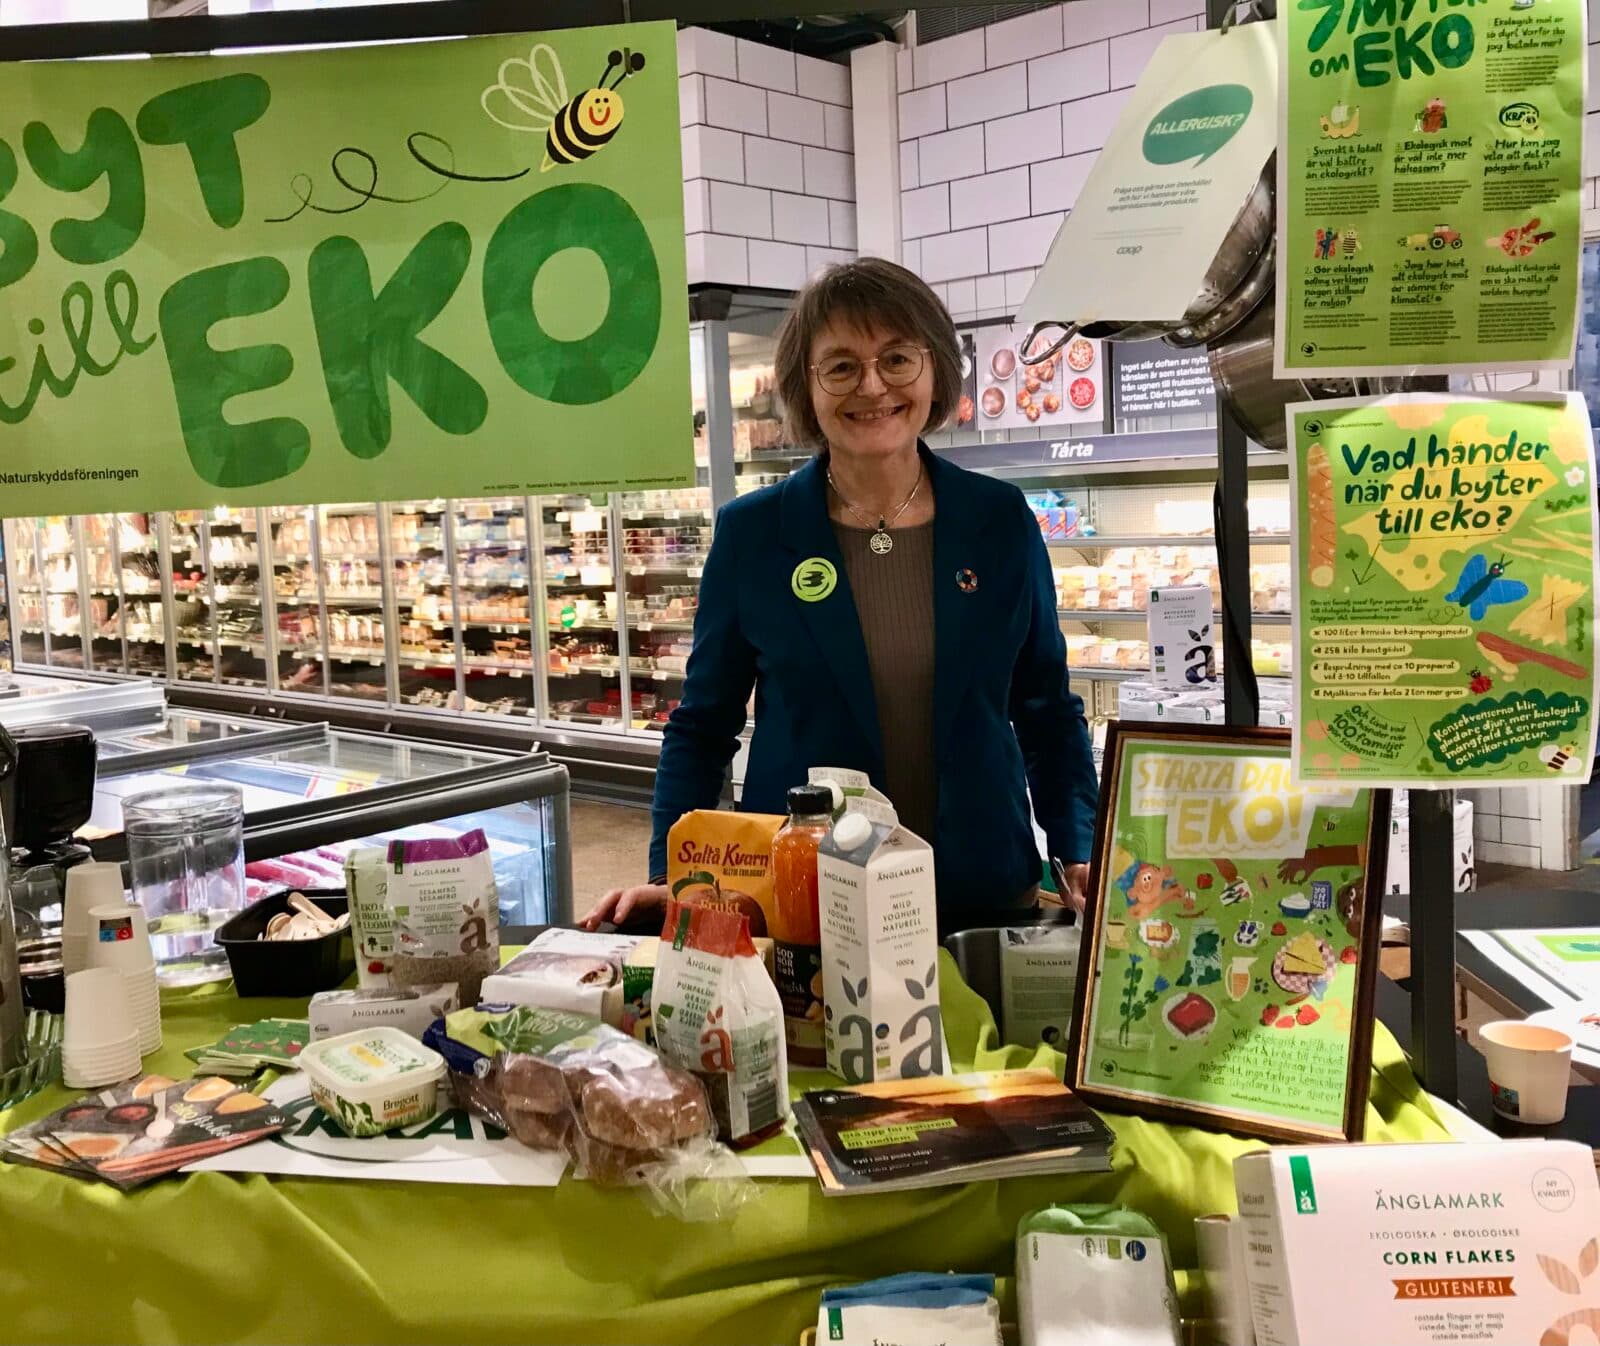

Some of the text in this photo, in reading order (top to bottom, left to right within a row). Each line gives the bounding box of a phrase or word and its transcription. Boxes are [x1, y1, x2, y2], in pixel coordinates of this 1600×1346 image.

[1353, 13, 1475, 87] EKO
[1150, 112, 1244, 136] ALLERGISK?
[1116, 245, 1143, 256] coop
[158, 182, 662, 489] EKO
[1121, 363, 1140, 374] Inget
[1141, 360, 1154, 369] slår
[1155, 359, 1179, 368] doften
[1121, 372, 1149, 382] känslan
[1150, 371, 1157, 379] är
[1176, 366, 1206, 377] starkast
[1122, 379, 1170, 392] från ugnen till
[1122, 393, 1149, 402] kortast.
[1175, 388, 1197, 398] bakar
[1198, 387, 1205, 395] vi
[1122, 404, 1129, 412] vi
[1130, 403, 1153, 411] hinner
[1154, 401, 1166, 409] här
[1171, 399, 1202, 408] butiken.
[1050, 442, 1093, 459] Tårta
[1341, 430, 1550, 476] Vad händer
[0, 468, 139, 485] Naturskyddsföreningen
[1344, 467, 1543, 504] när du byter
[1375, 499, 1513, 534] till eko?
[1324, 629, 1338, 637] 100
[1534, 702, 1581, 721] biologisk
[1332, 713, 1357, 738] 100
[1433, 700, 1537, 741] Konsekvenserna blir
[1455, 751, 1477, 766] och
[1137, 758, 1235, 790] STARTA
[1177, 795, 1304, 846] EKO!
[678, 840, 769, 869] Saltå Kvarn
[892, 900, 911, 909] MILD
[882, 907, 921, 922] YOGHURT
[882, 918, 921, 933] NATURELL
[383, 1093, 420, 1111] Bregott
[1545, 1180, 1557, 1188] NY
[1369, 1229, 1521, 1240] EKOLOGISKA ØKOLOGISKE
[1382, 1249, 1516, 1265] CORN FLAKES
[1404, 1280, 1504, 1298] GLUTENFRI
